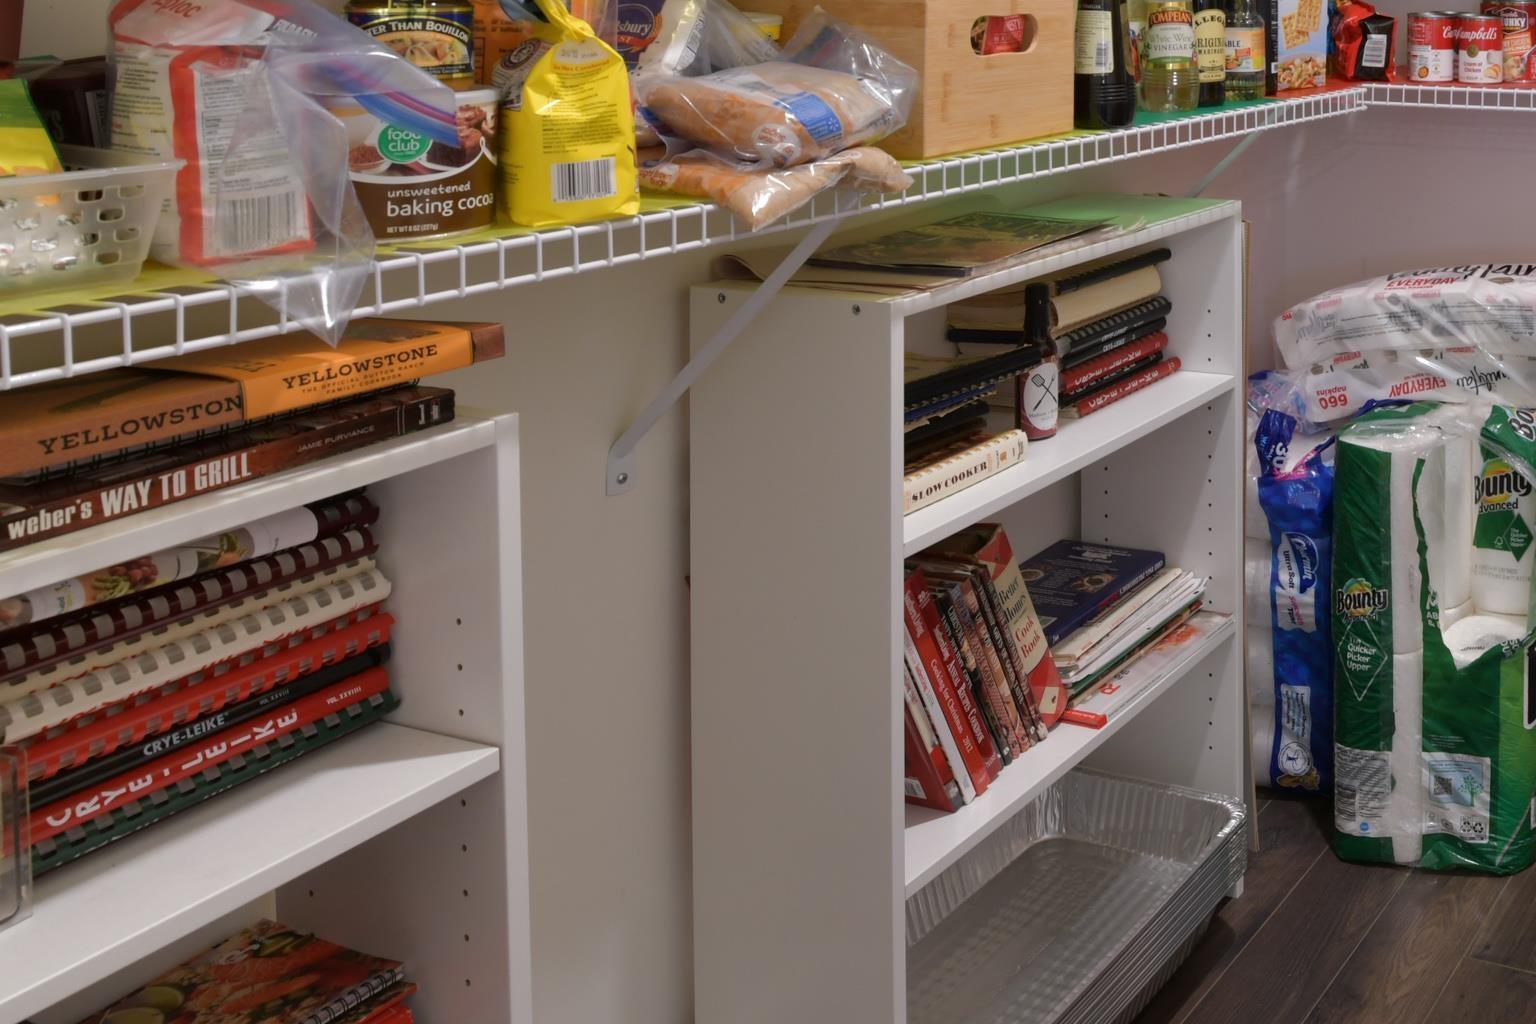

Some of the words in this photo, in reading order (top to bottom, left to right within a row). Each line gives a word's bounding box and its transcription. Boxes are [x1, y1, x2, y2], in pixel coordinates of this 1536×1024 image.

[388, 20, 423, 32] THAN
[425, 20, 469, 44] BOUILLON
[1154, 44, 1189, 52] VINEGAR
[388, 135, 420, 153] club
[387, 181, 471, 199] unsweetened
[386, 197, 454, 227] baking
[1386, 277, 1458, 288] EVERYDAY
[282, 344, 438, 389] YELLOWSTONE
[320, 378, 360, 390] OFFICIAL
[325, 385, 357, 395] FAMILY
[359, 374, 401, 388] COOKBOOK
[1316, 386, 1348, 396] napkins
[1389, 377, 1448, 398] EVERYDAY
[1318, 394, 1349, 410] 660
[38, 393, 243, 456] YELLOWSTON
[297, 439, 322, 453] JAMIE
[324, 425, 376, 446] PURVIANCE
[911, 482, 943, 502] SLOW
[944, 461, 988, 489] COOKER
[8, 498, 93, 542] weber's
[101, 481, 151, 518] WAY
[160, 473, 187, 502] TO
[194, 451, 253, 493] GRILL
[1287, 570, 1297, 590] Soft
[999, 577, 1020, 606] Better
[1336, 587, 1389, 613] Bounty
[1003, 594, 1028, 624] Homes
[1014, 614, 1036, 643] Cook
[1020, 634, 1042, 660] Book
[1346, 653, 1371, 663] Picker
[1347, 642, 1377, 655] Quicker
[1346, 661, 1371, 673] Upper
[142, 714, 226, 757] CRYE-LEIKE
